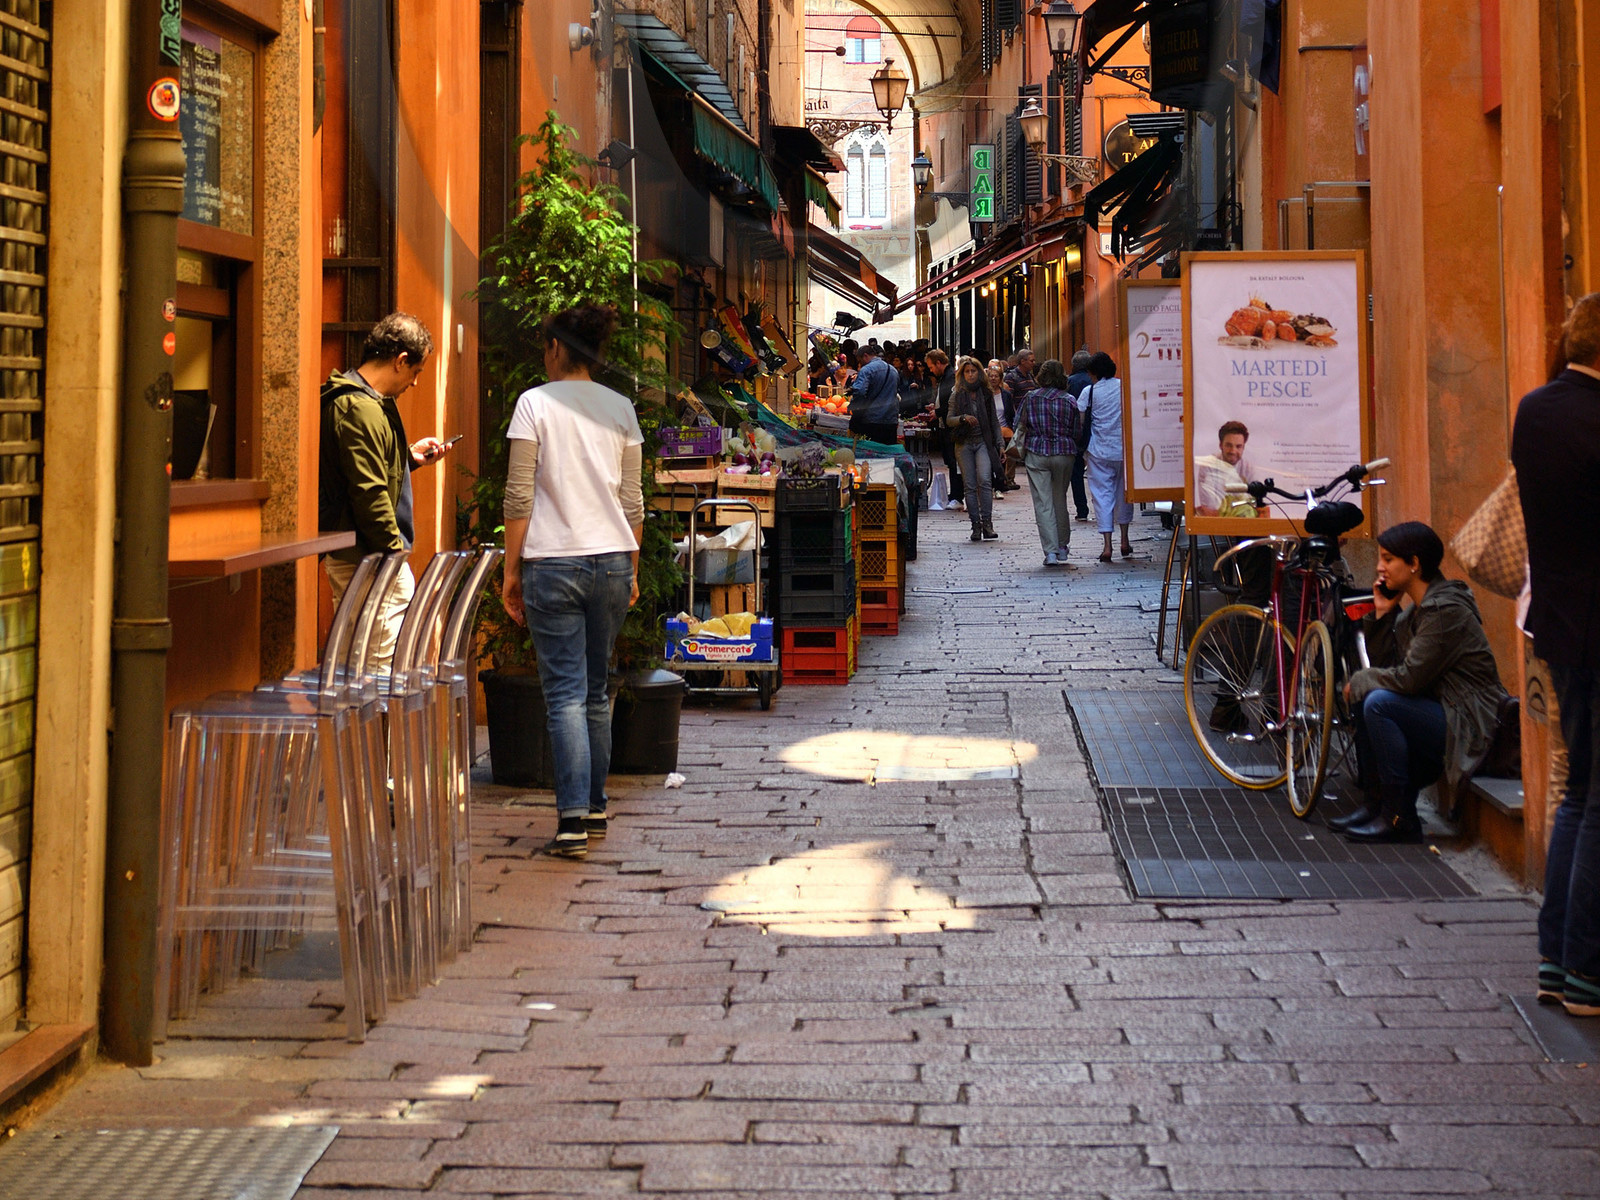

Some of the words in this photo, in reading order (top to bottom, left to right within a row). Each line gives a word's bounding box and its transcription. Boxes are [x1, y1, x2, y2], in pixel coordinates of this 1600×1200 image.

[1133, 304, 1159, 313] TUTTO
[1136, 331, 1151, 359] 2
[1231, 355, 1328, 376] MARTEDÌ
[1247, 381, 1313, 398] PESCE
[1140, 443, 1156, 472] 0
